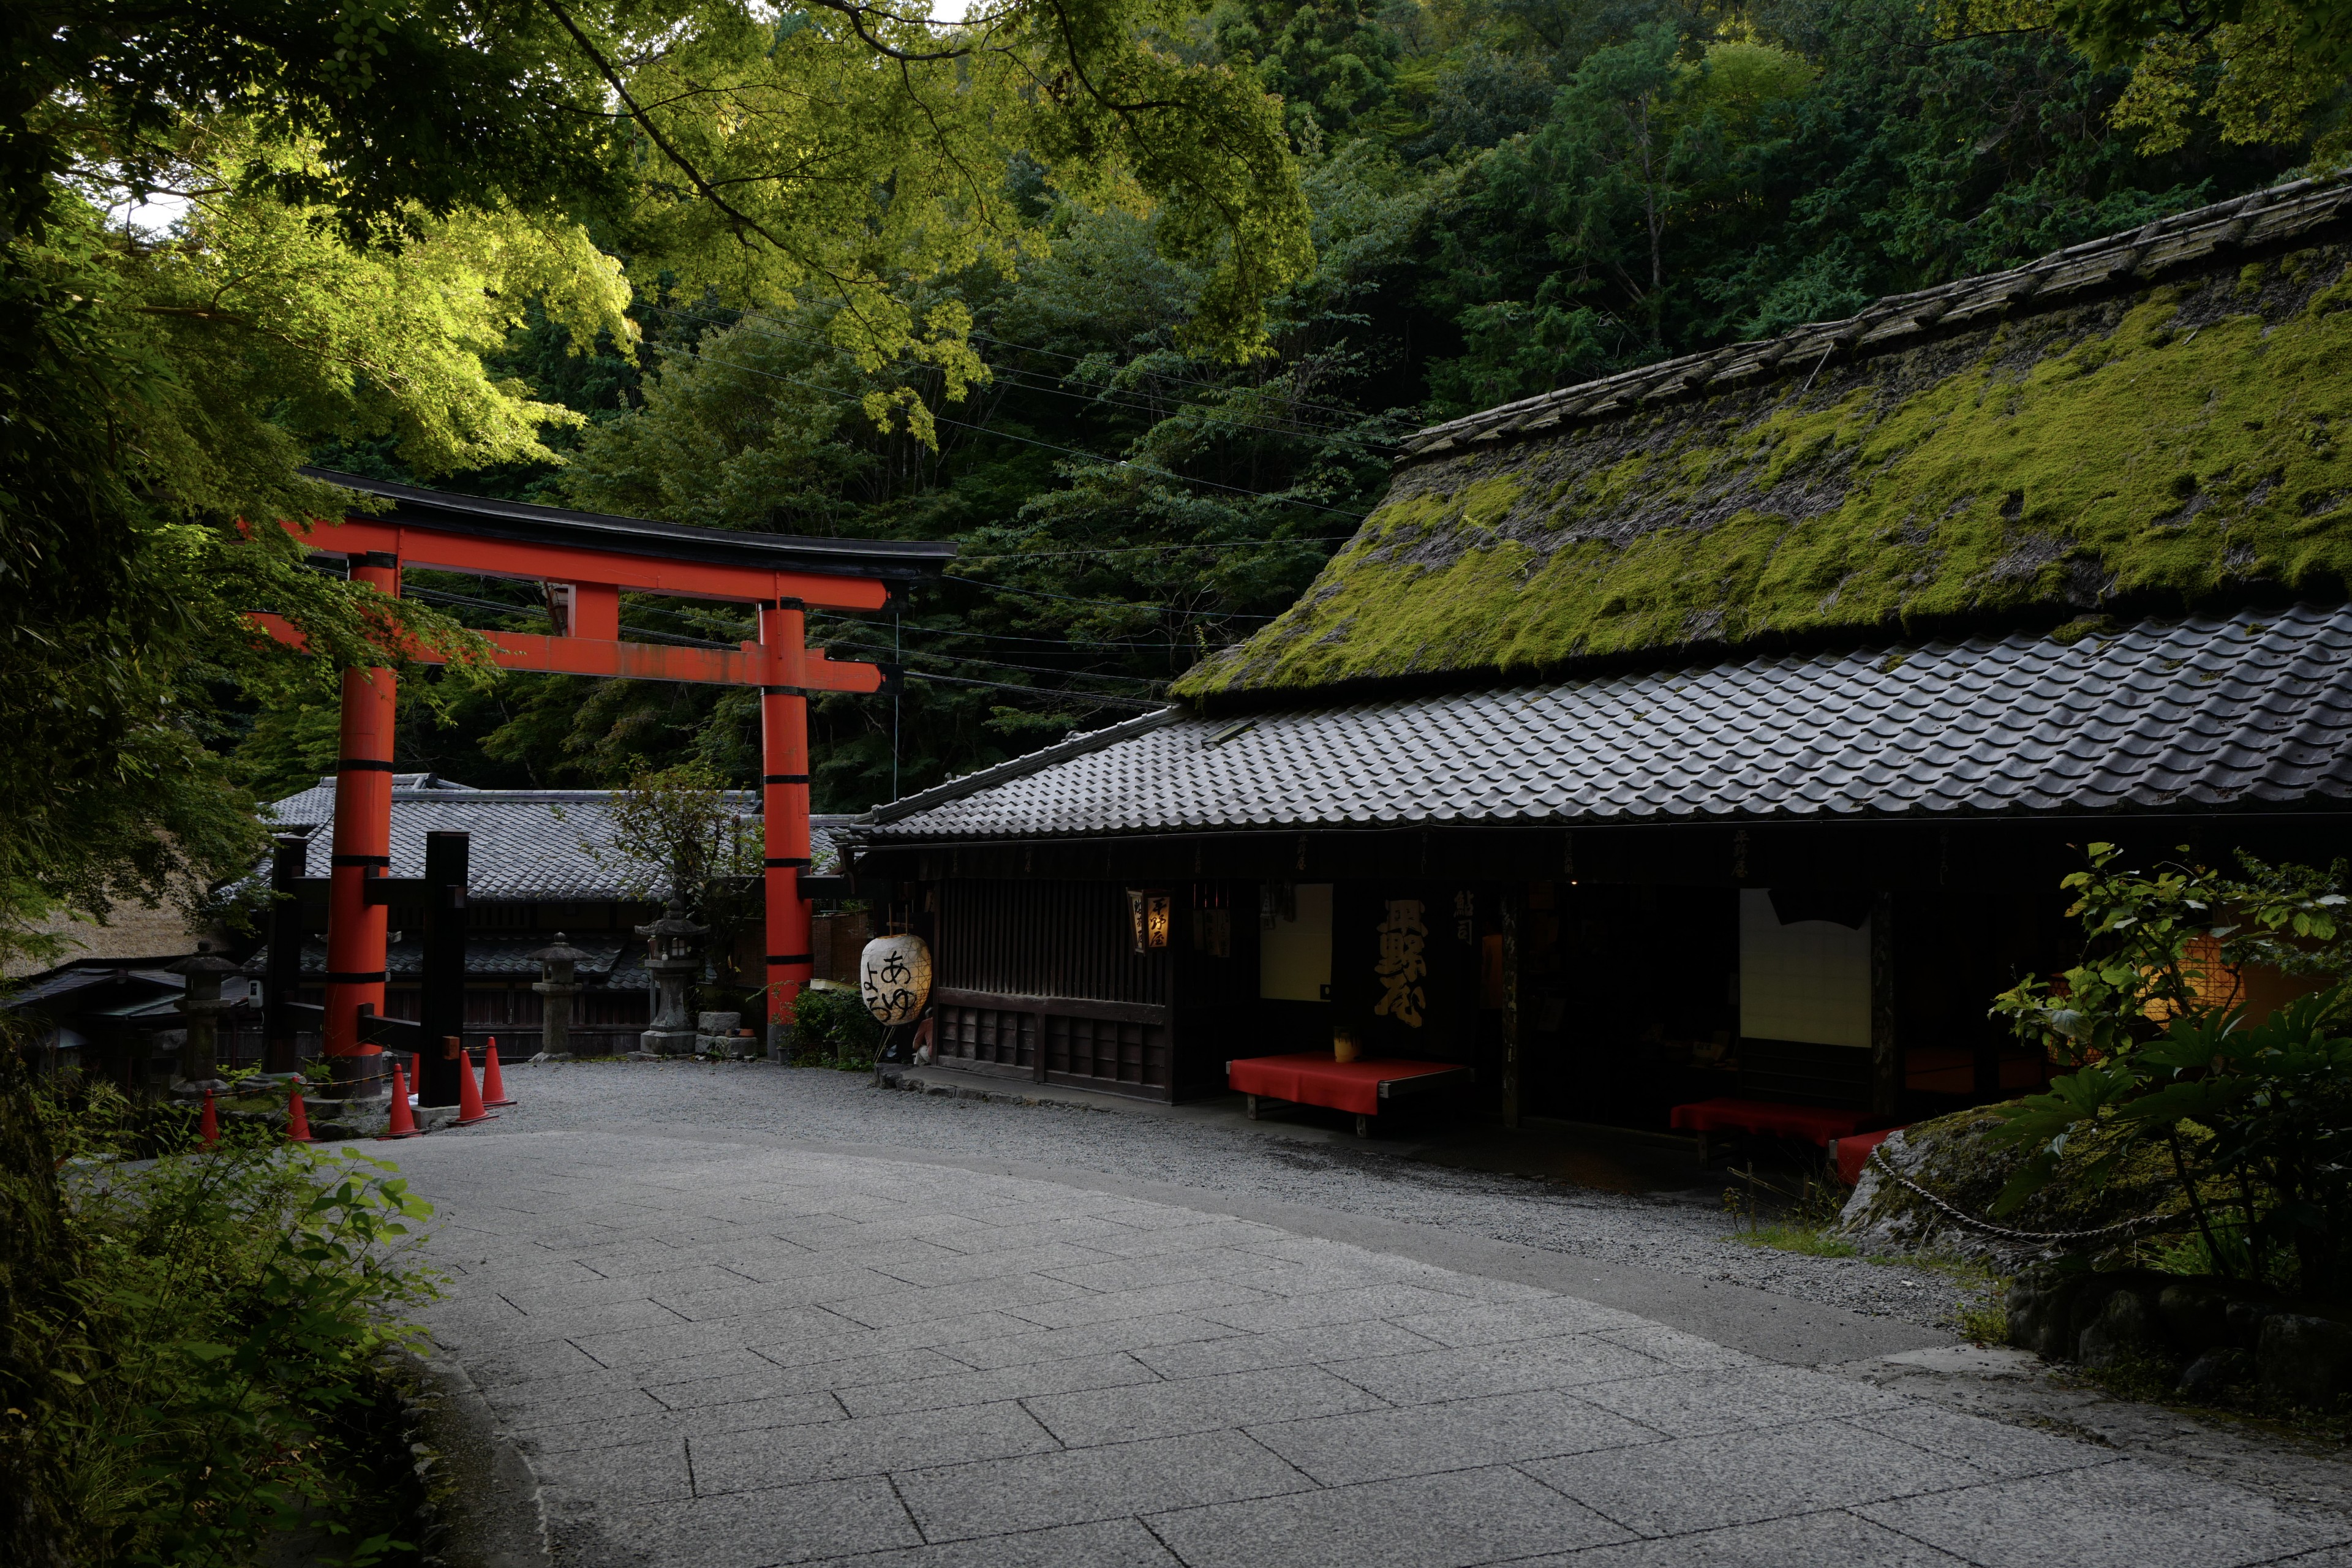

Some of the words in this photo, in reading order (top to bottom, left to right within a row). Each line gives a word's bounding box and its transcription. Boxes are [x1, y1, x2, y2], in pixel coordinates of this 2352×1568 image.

[1731, 829, 1750, 878] 平野屋
[1150, 898, 1167, 946] 平野屋
[1453, 890, 1475, 946] 鮎司
[881, 950, 918, 1020] あゆ
[1374, 898, 1430, 1028] 平野屋
